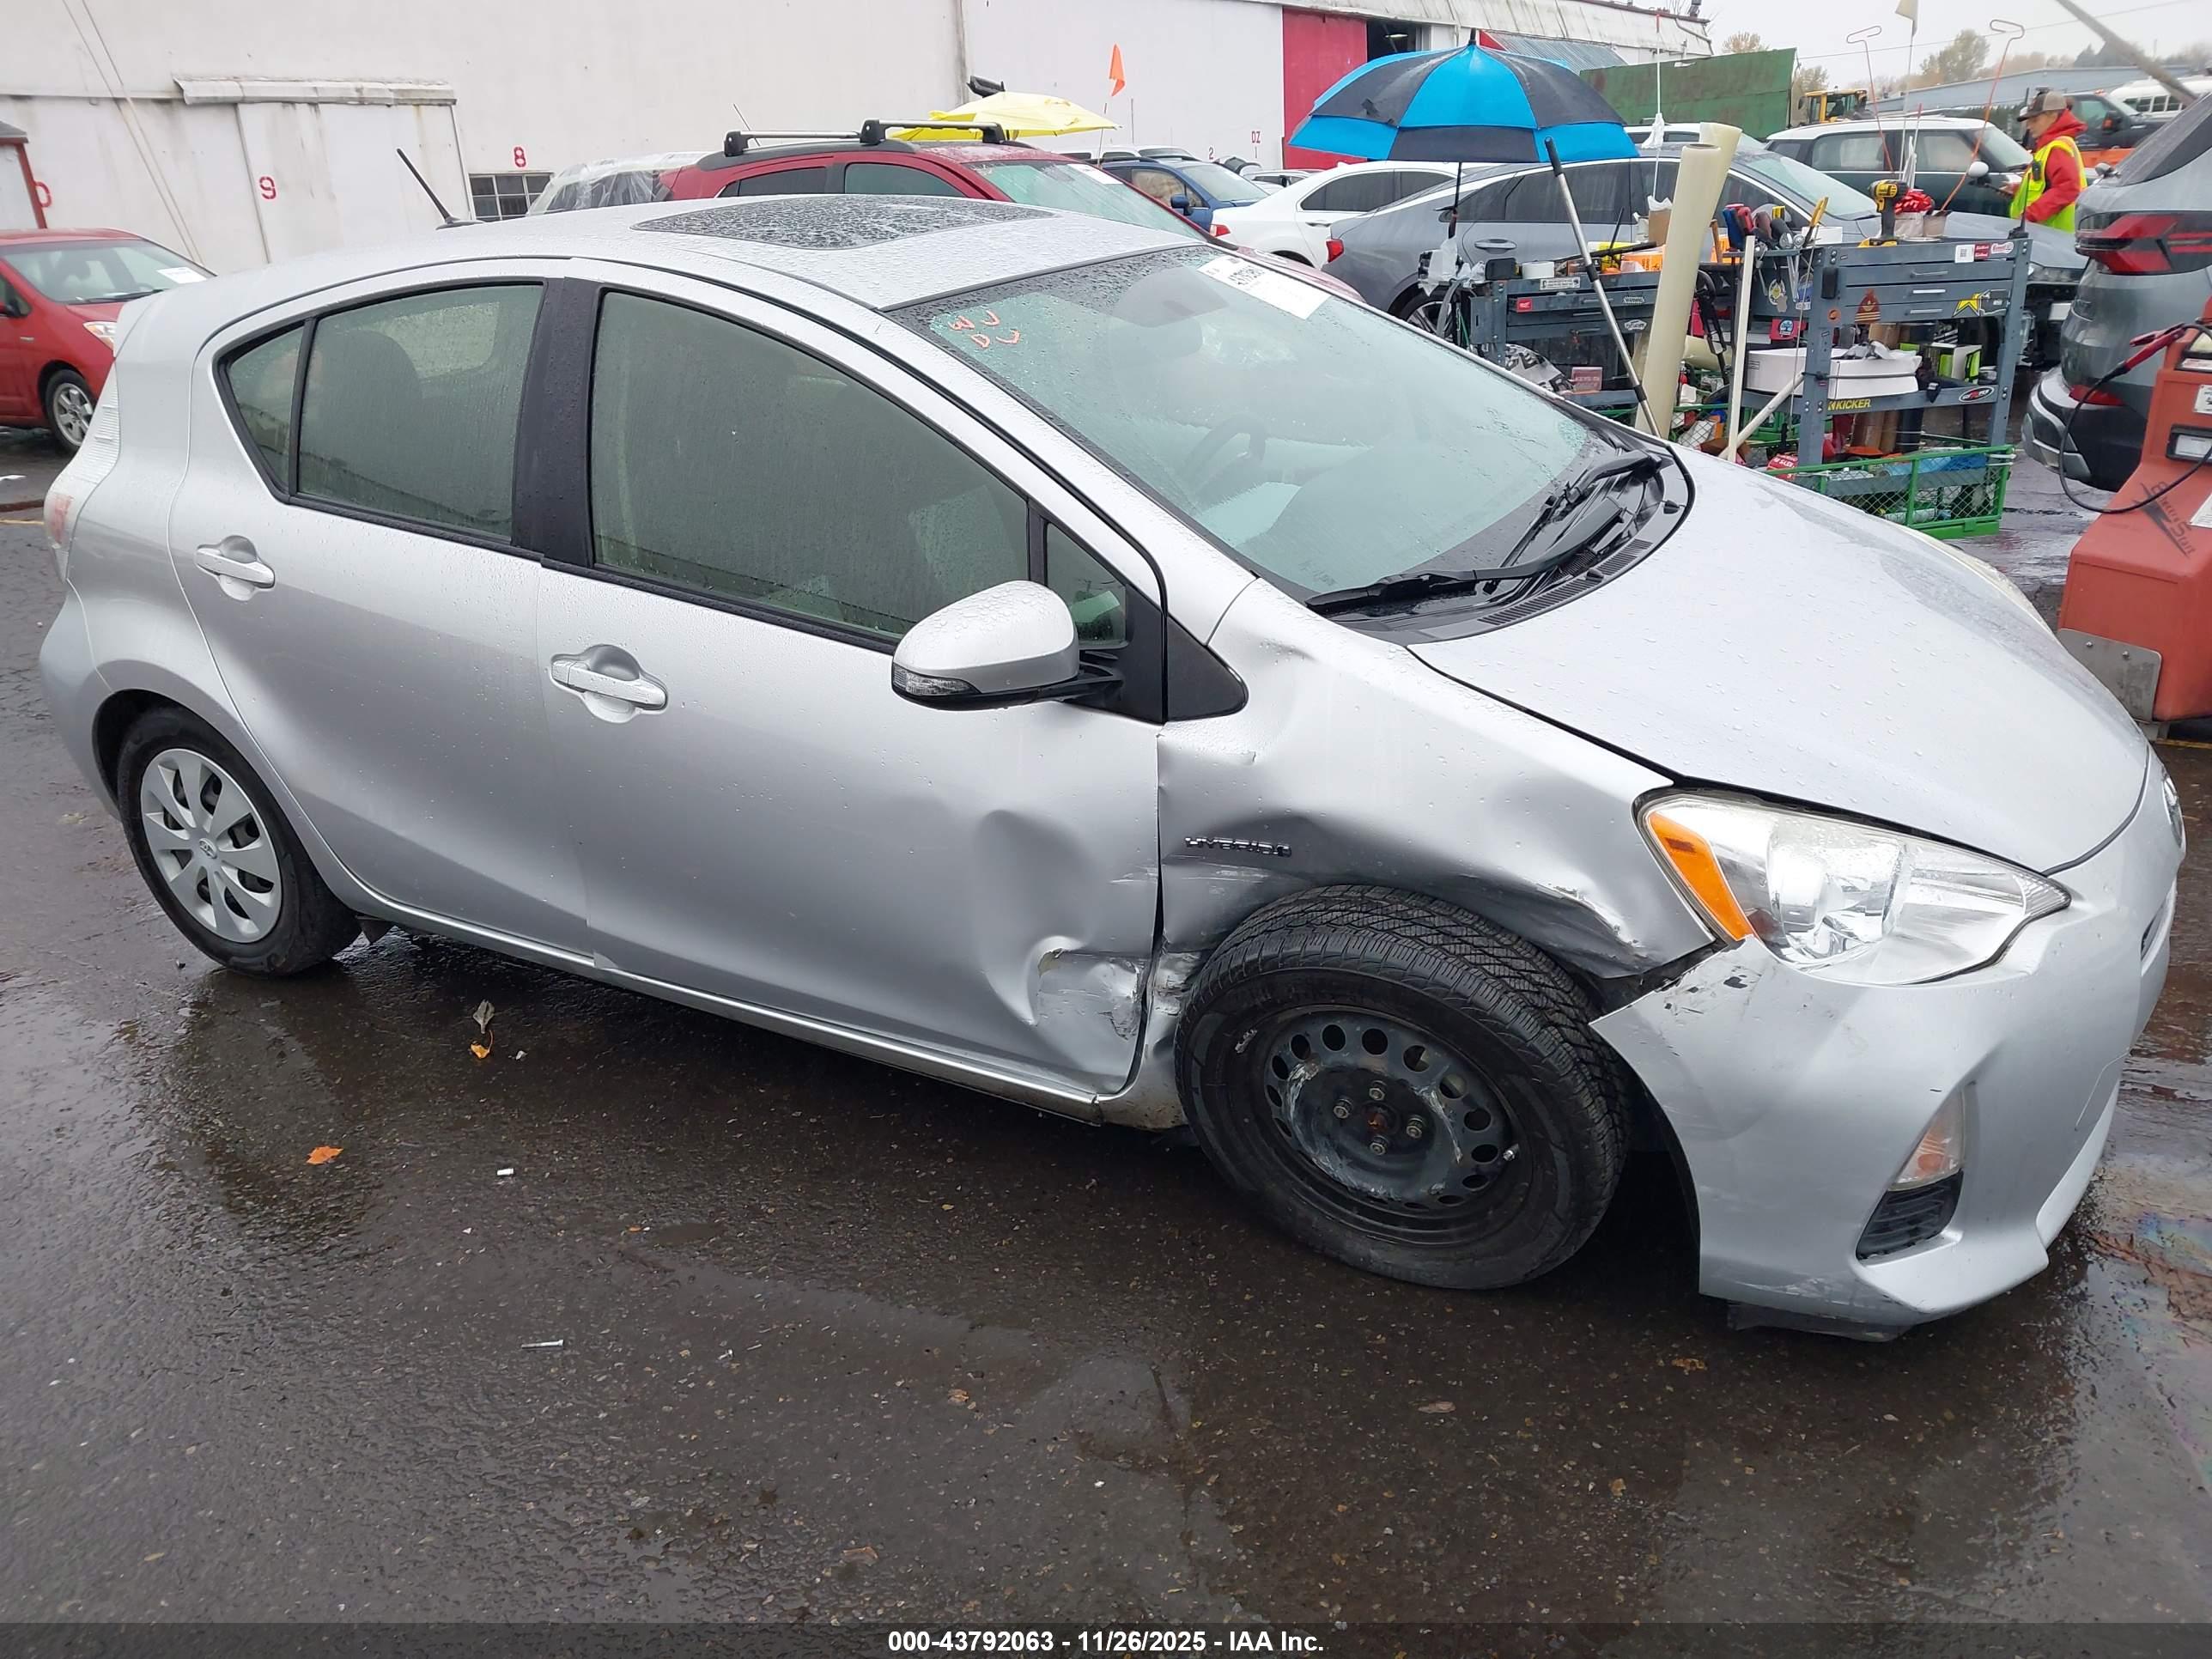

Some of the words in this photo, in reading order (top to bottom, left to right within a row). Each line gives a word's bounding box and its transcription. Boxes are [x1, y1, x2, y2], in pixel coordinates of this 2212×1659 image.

[514, 146, 526, 167] 8
[1208, 146, 1214, 160] 2
[258, 176, 276, 199] 9
[1836, 398, 1871, 410] KICKER
